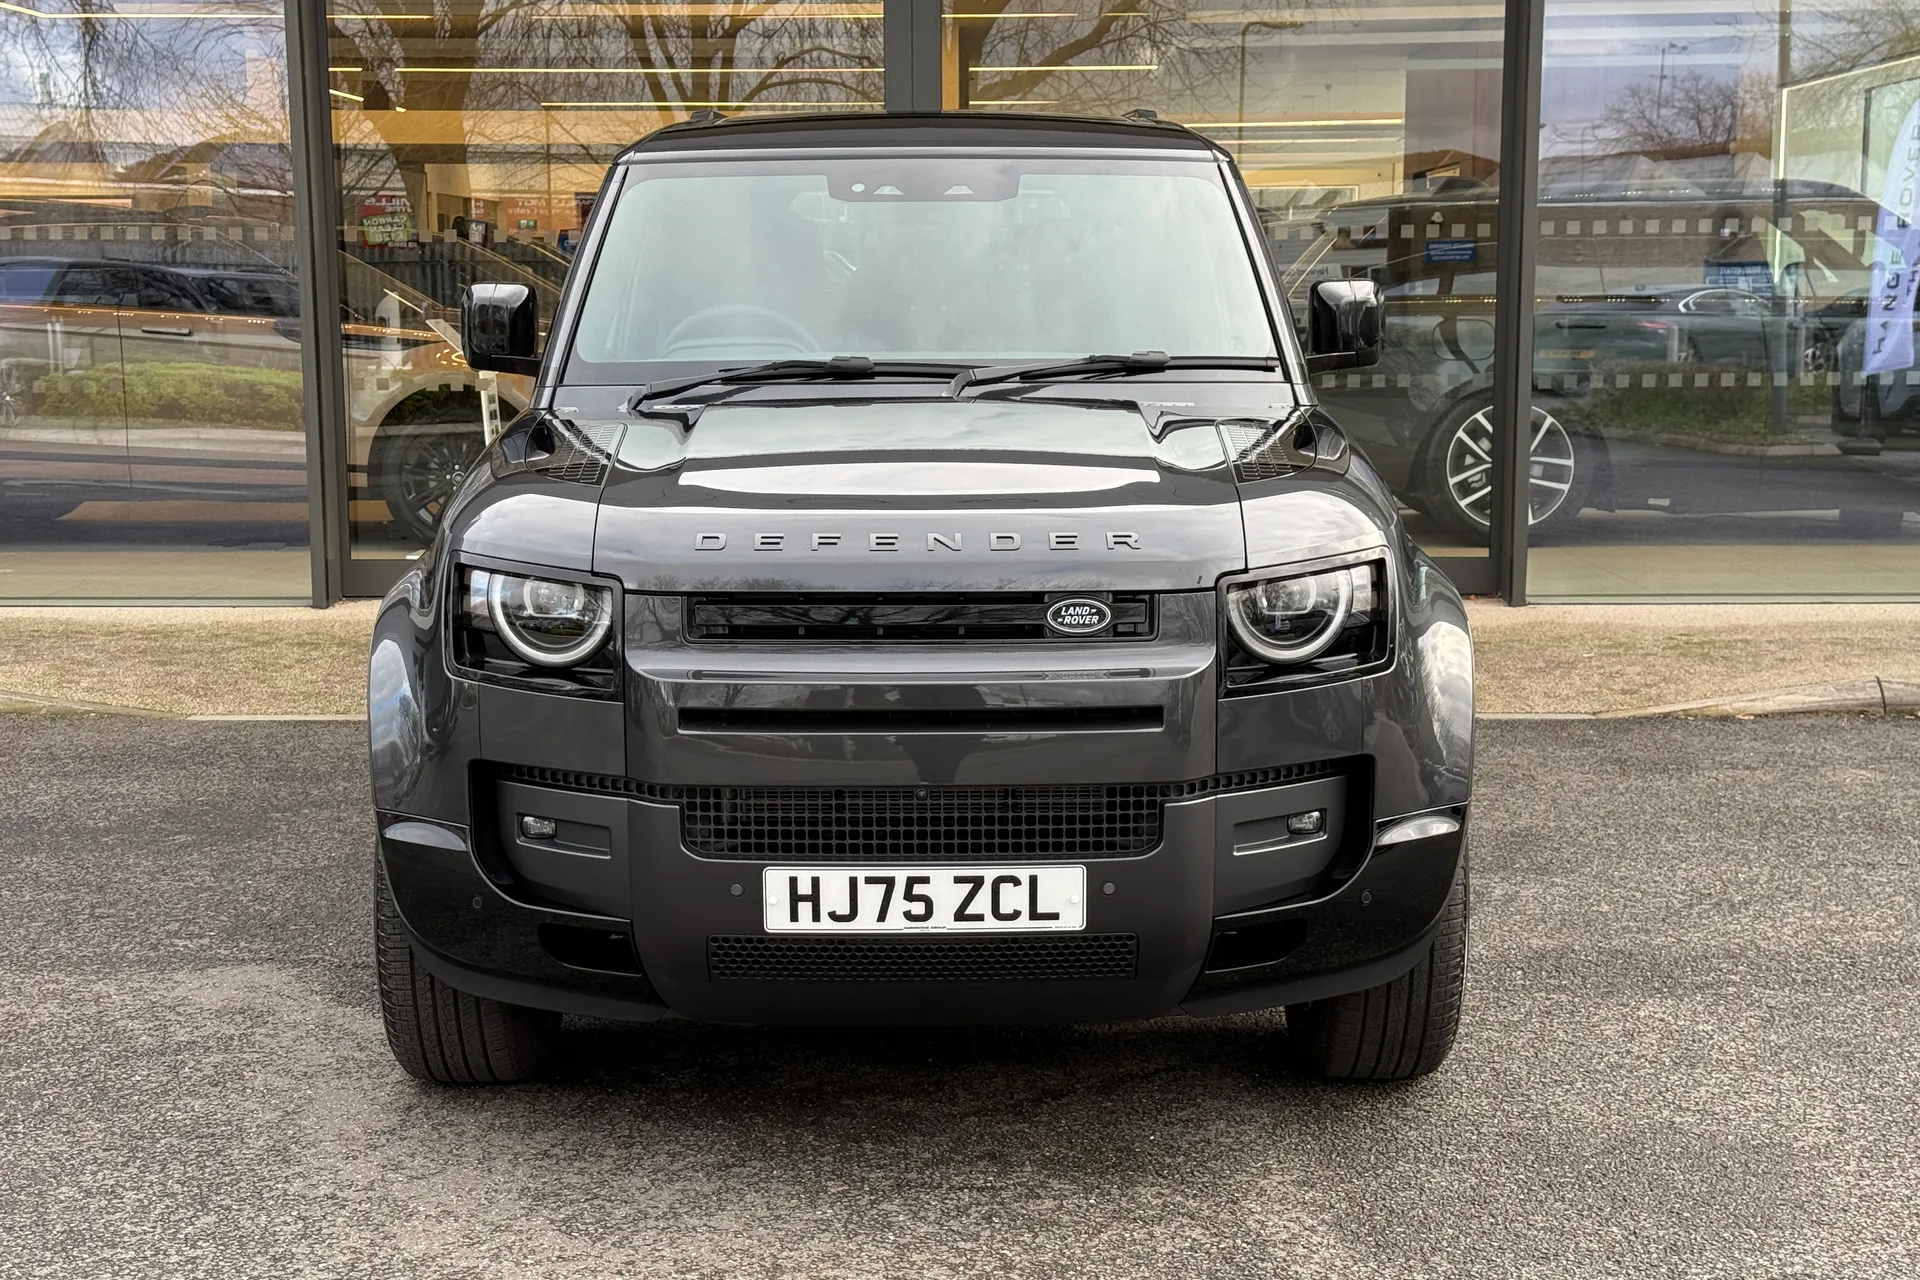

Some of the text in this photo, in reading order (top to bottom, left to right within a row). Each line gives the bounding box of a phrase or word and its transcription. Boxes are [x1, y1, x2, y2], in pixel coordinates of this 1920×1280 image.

[694, 532, 1141, 551] DEFENDER
[788, 874, 1060, 923] HJ75 ZCL
